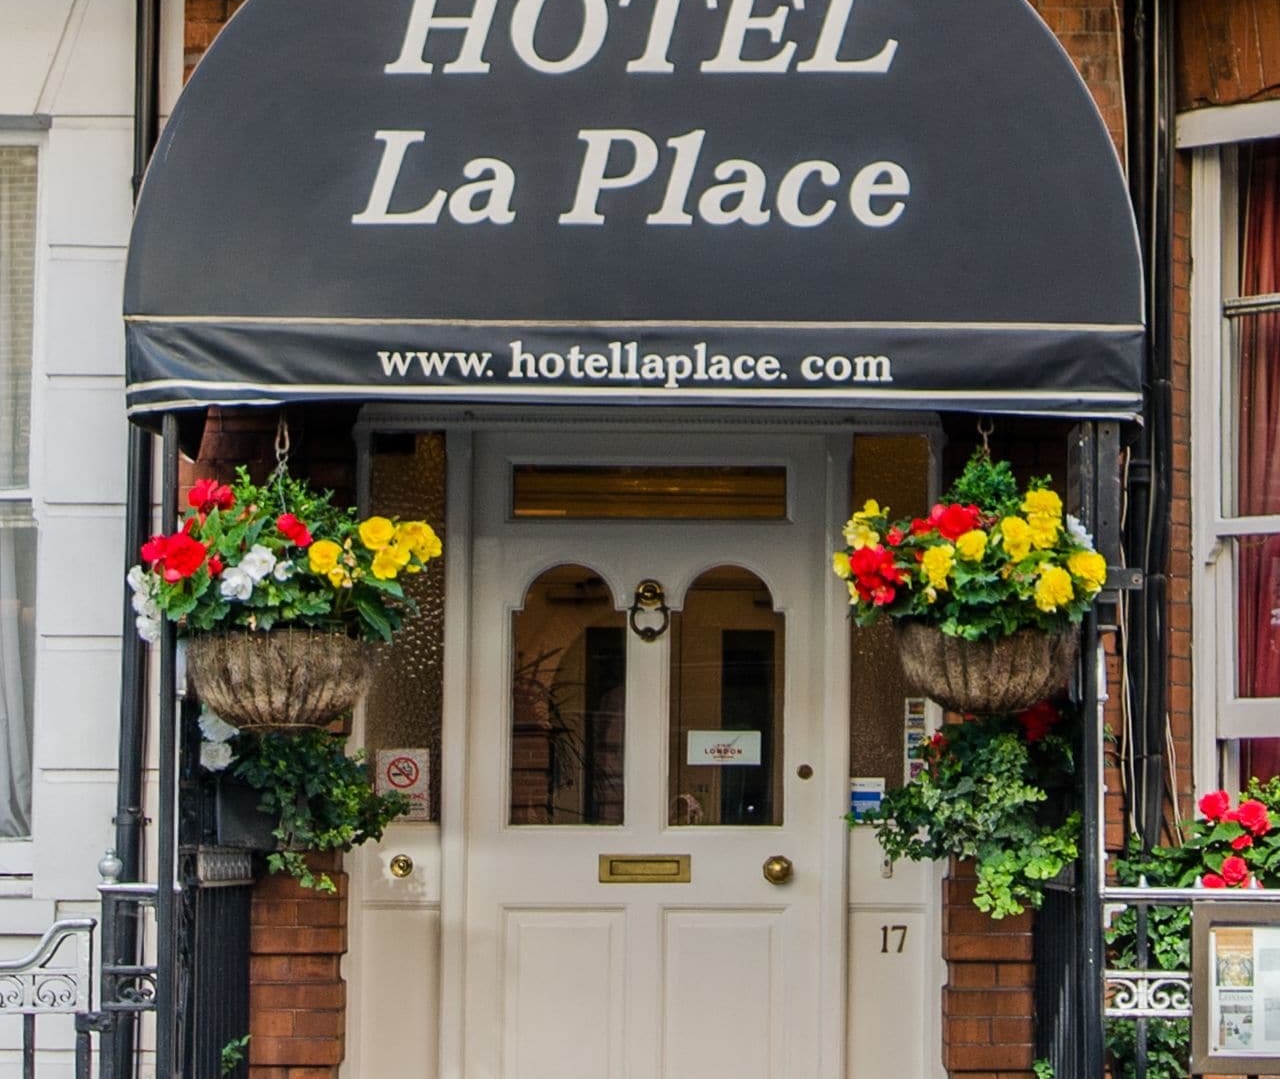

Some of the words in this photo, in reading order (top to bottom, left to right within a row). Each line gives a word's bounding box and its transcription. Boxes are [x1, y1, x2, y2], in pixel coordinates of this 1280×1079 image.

[351, 130, 515, 224] La
[558, 130, 910, 227] Place
[880, 925, 907, 953] 17
